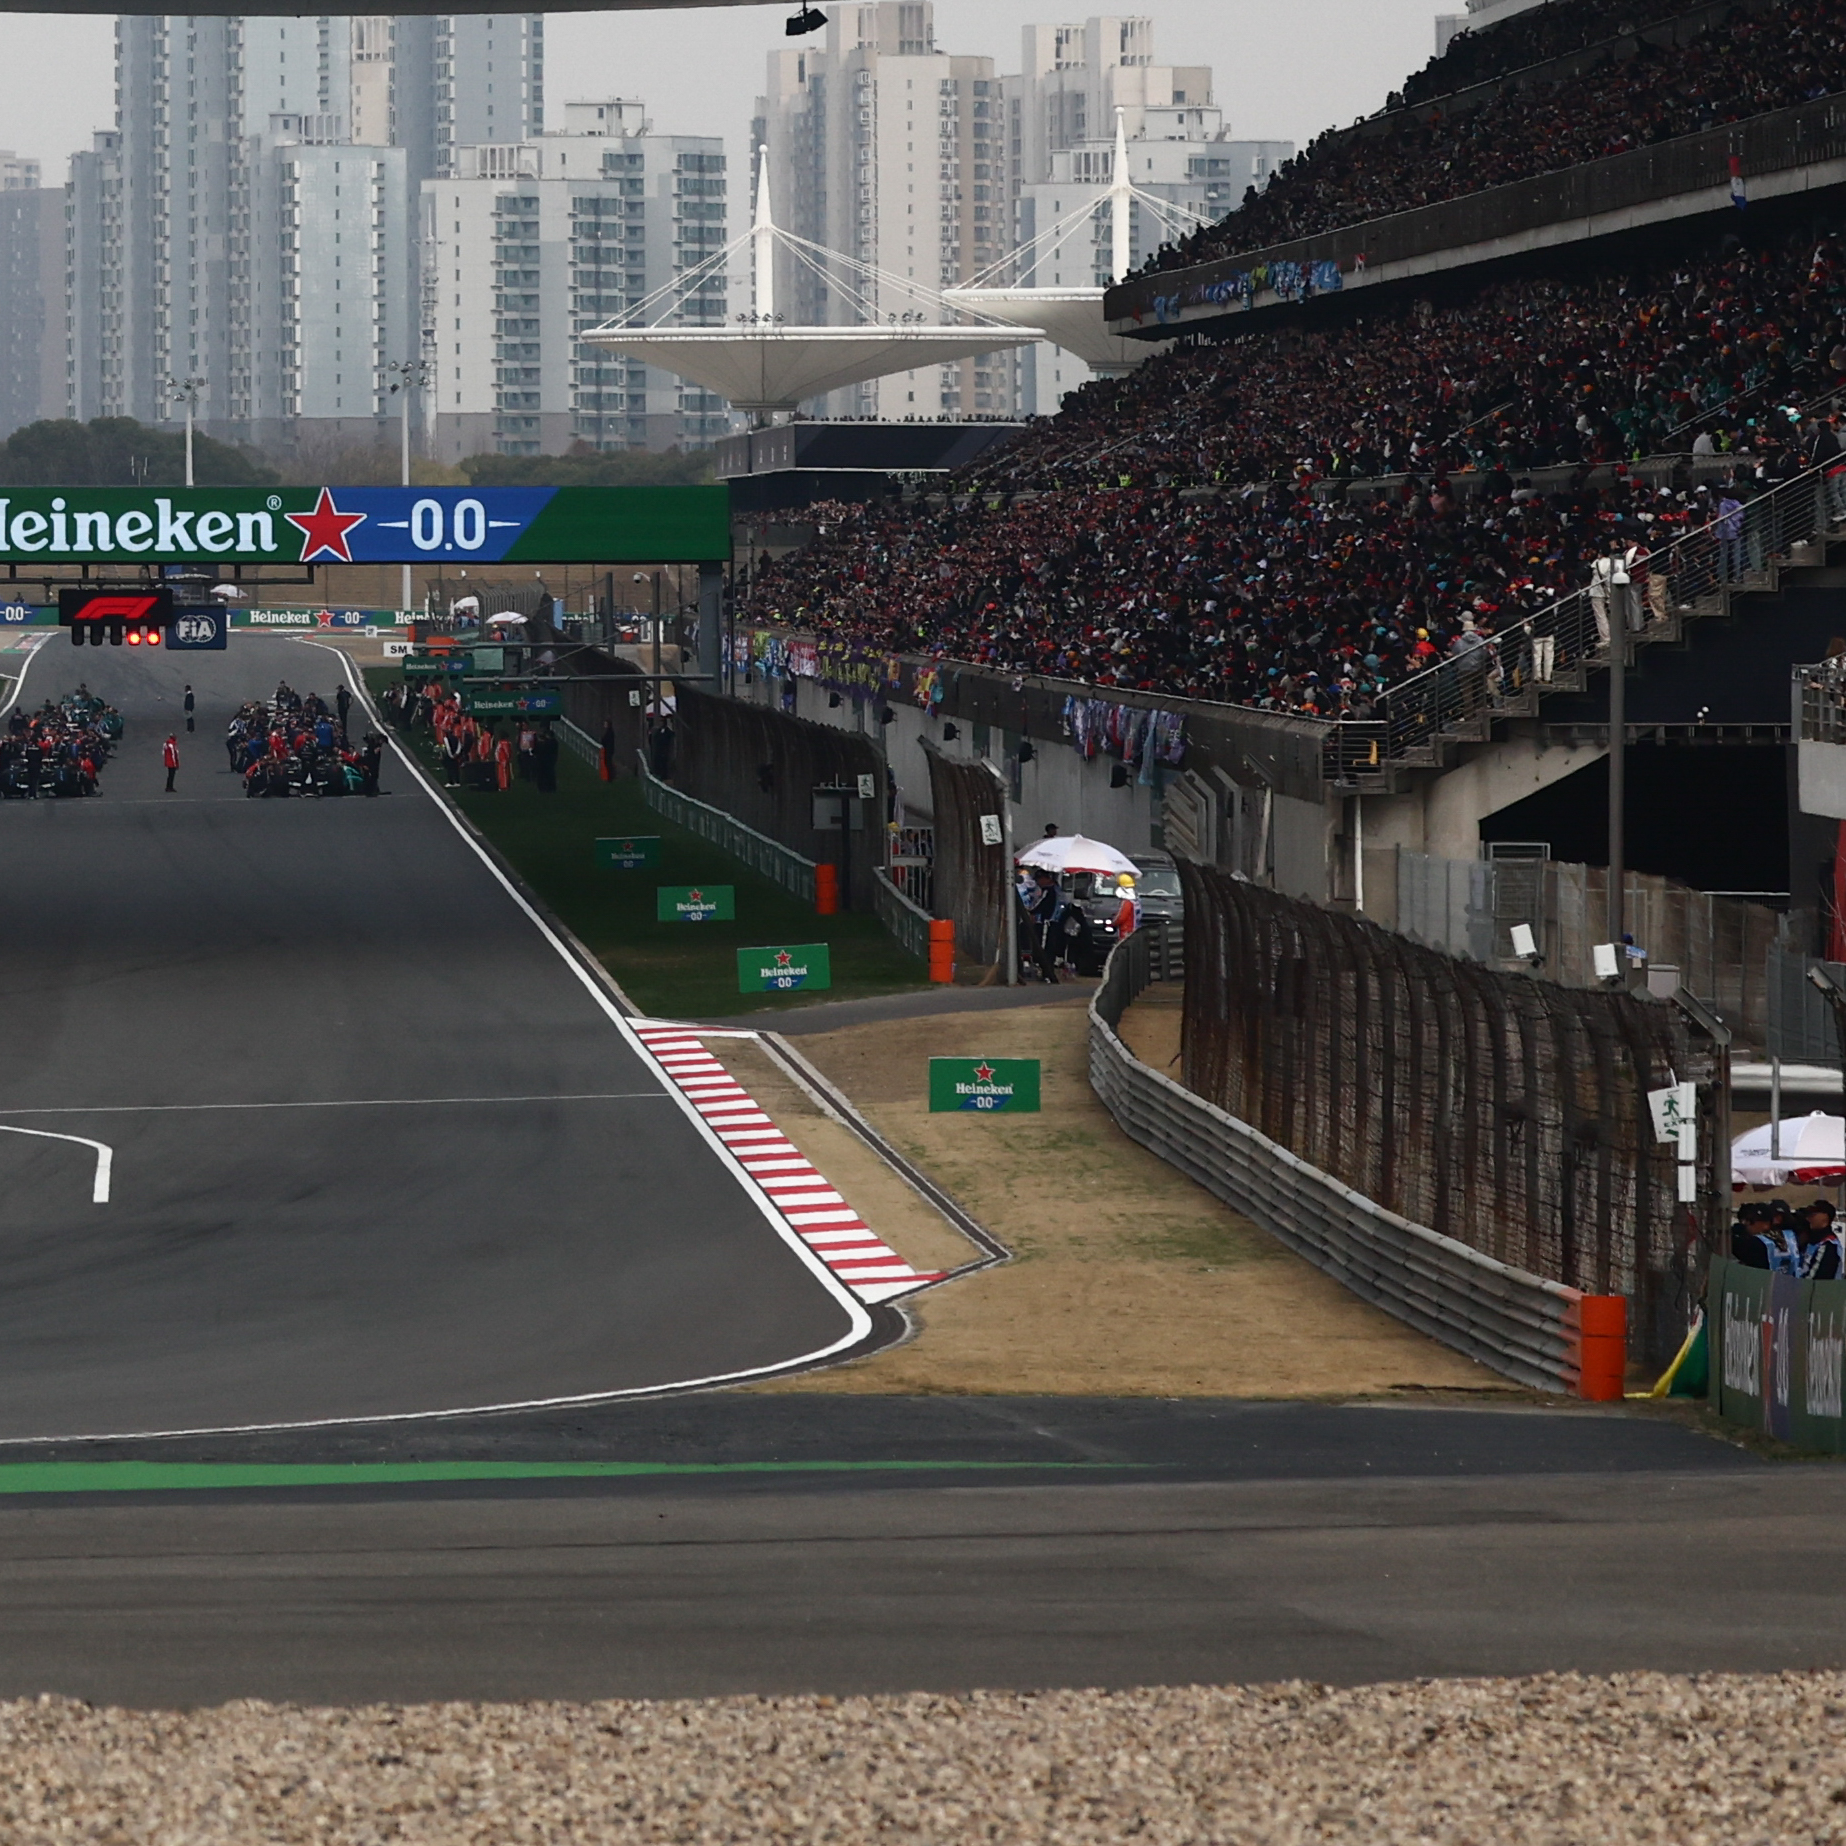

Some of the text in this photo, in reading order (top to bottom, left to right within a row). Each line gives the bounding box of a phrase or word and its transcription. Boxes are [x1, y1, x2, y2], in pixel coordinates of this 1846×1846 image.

[412, 499, 485, 551] 0.0
[391, 645, 408, 654] SM
[955, 1082, 1014, 1095] Heineken
